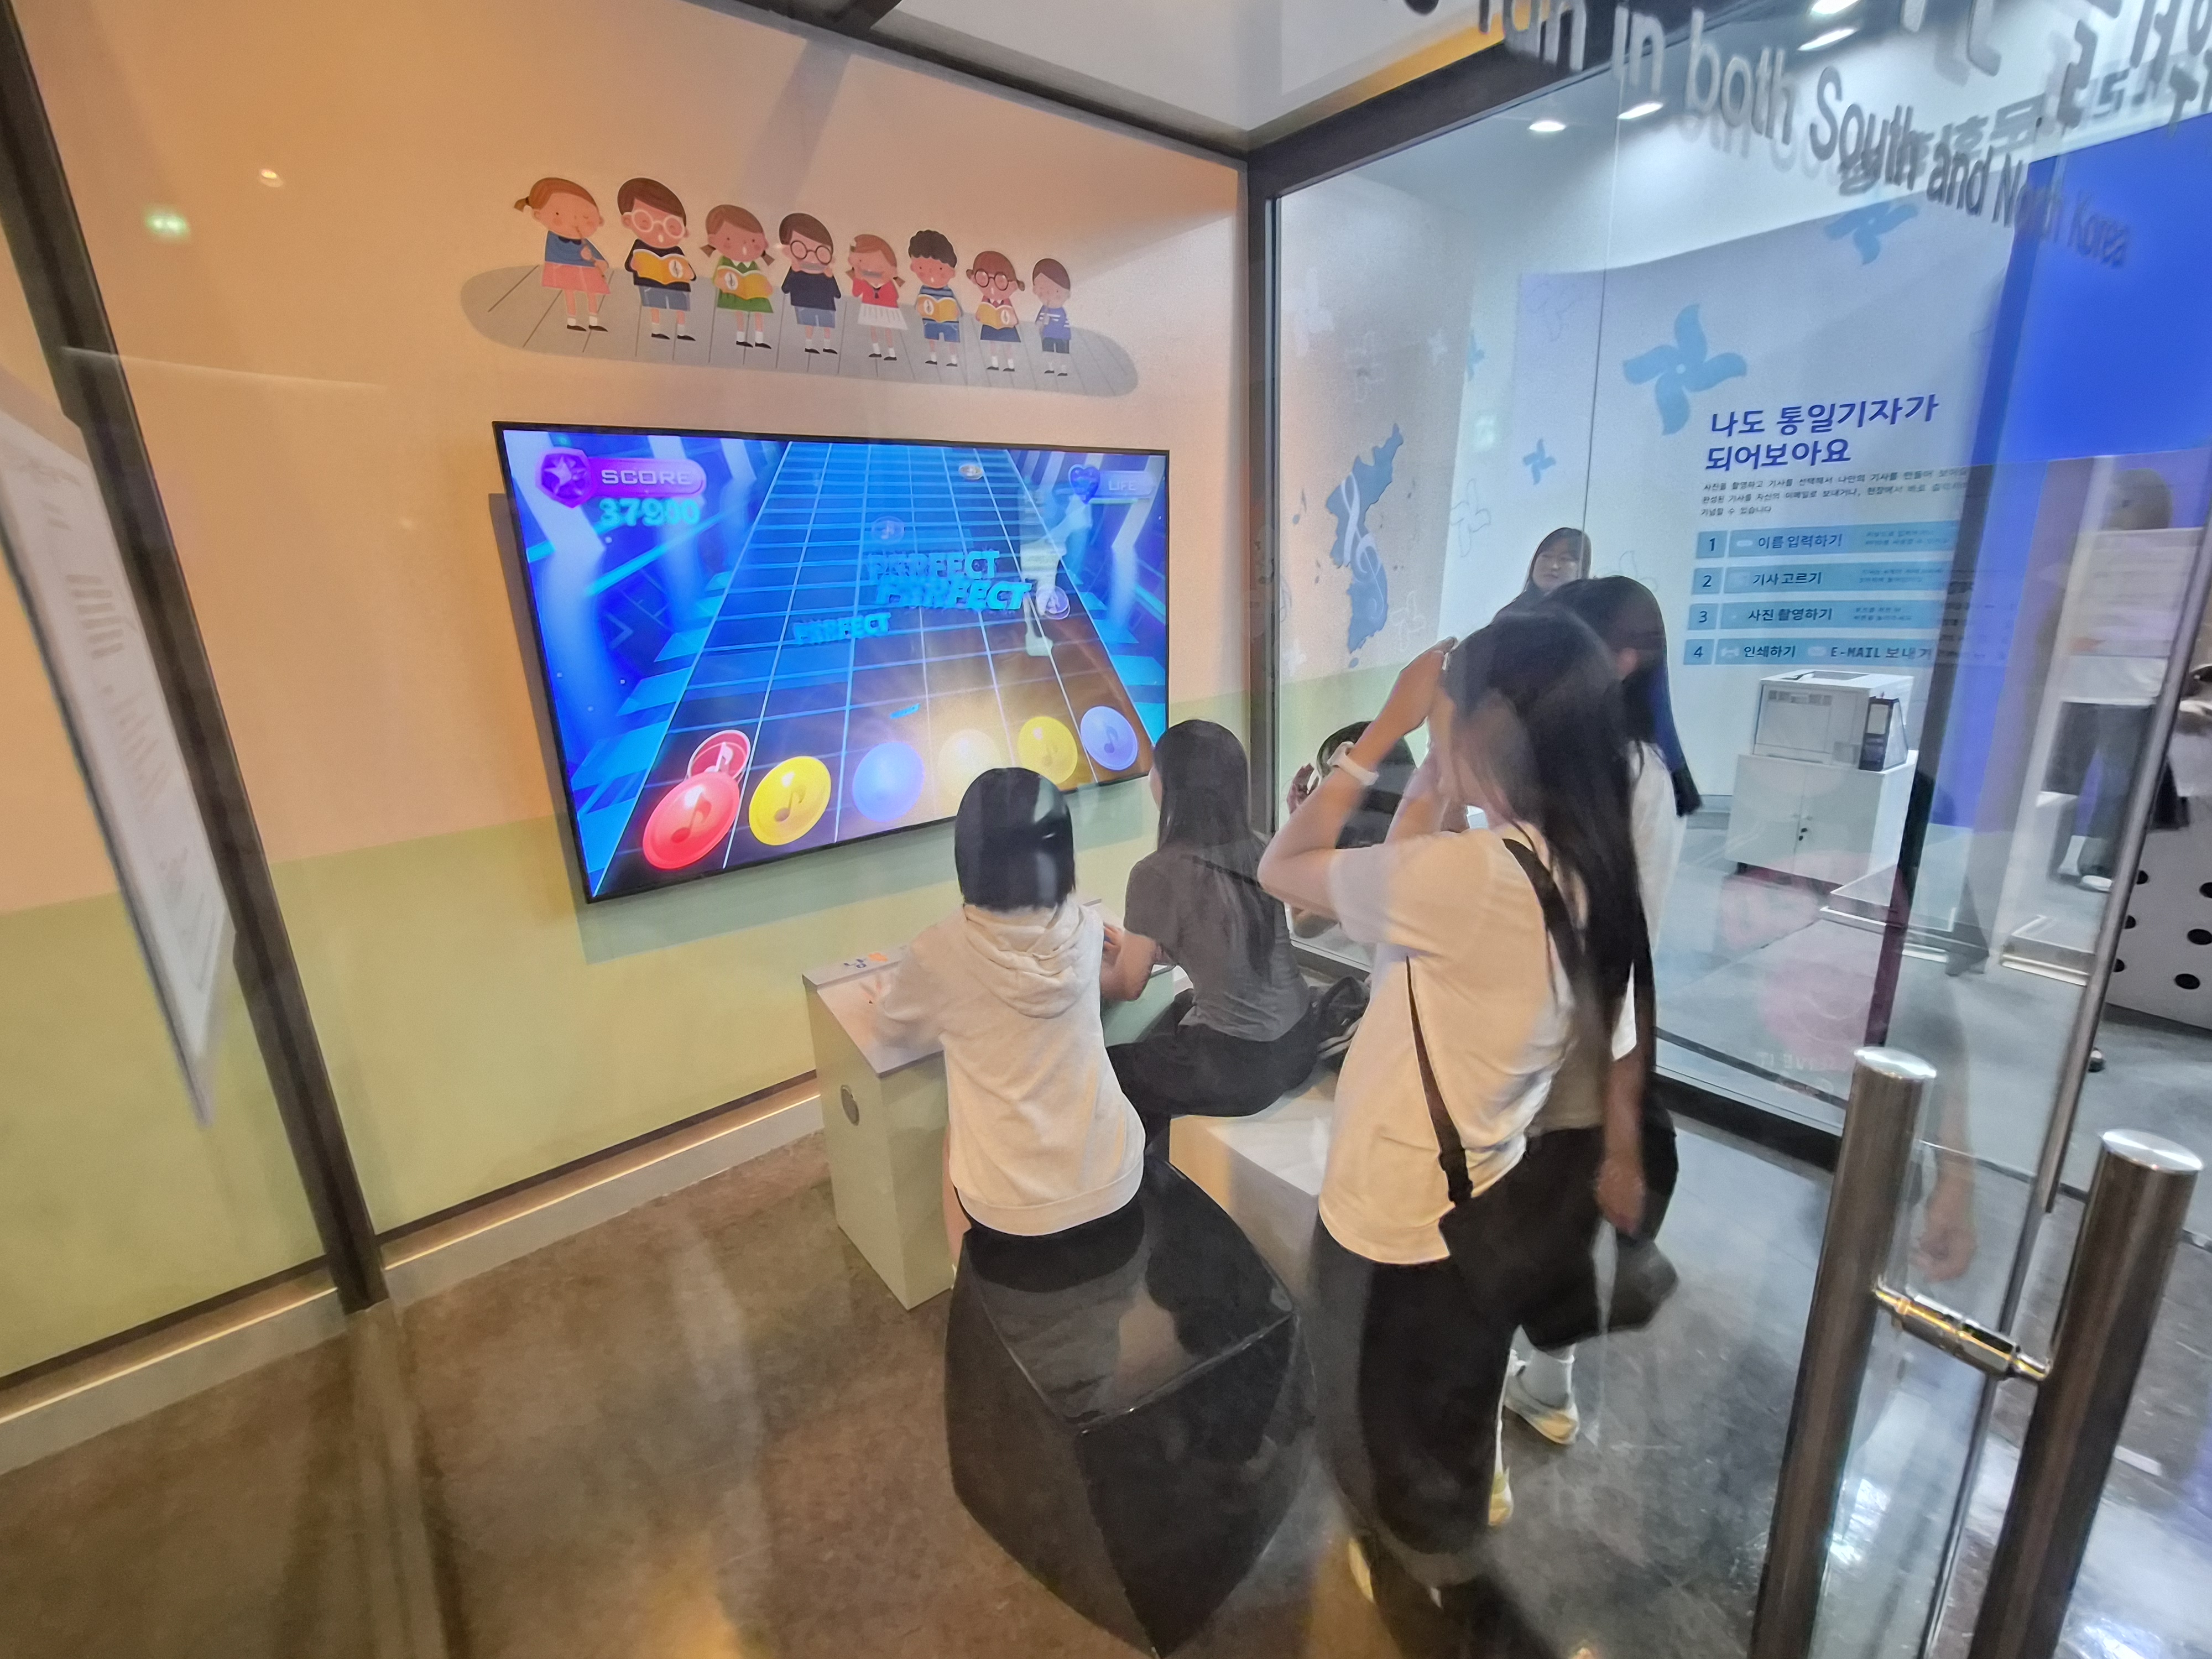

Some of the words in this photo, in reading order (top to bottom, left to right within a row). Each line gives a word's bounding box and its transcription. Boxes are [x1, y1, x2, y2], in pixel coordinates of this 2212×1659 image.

[1685, 8, 1794, 145] both
[1809, 66, 1914, 191] South
[1926, 145, 1995, 216] and
[1710, 410, 1765, 437] 나도
[1776, 394, 1939, 436] 통일기자가
[1705, 439, 1851, 471] 되어보아요
[601, 469, 692, 485] SCORE
[1109, 480, 1136, 491] LIFE
[1709, 538, 1716, 551] 1
[1759, 536, 1785, 549] 이름
[1788, 534, 1843, 549] 입력하기
[1702, 575, 1712, 587] 2
[1752, 573, 1779, 586] 기사
[1781, 572, 1822, 585] 고르기
[1698, 611, 1708, 623] 3
[1748, 609, 1774, 621] 사진
[1778, 608, 1833, 621] 촬영하기
[1693, 646, 1703, 658] 4
[1744, 645, 1796, 658] 인쇄하기
[1830, 647, 1880, 658] E-MAIL
[1885, 648, 1932, 660] 보내기
